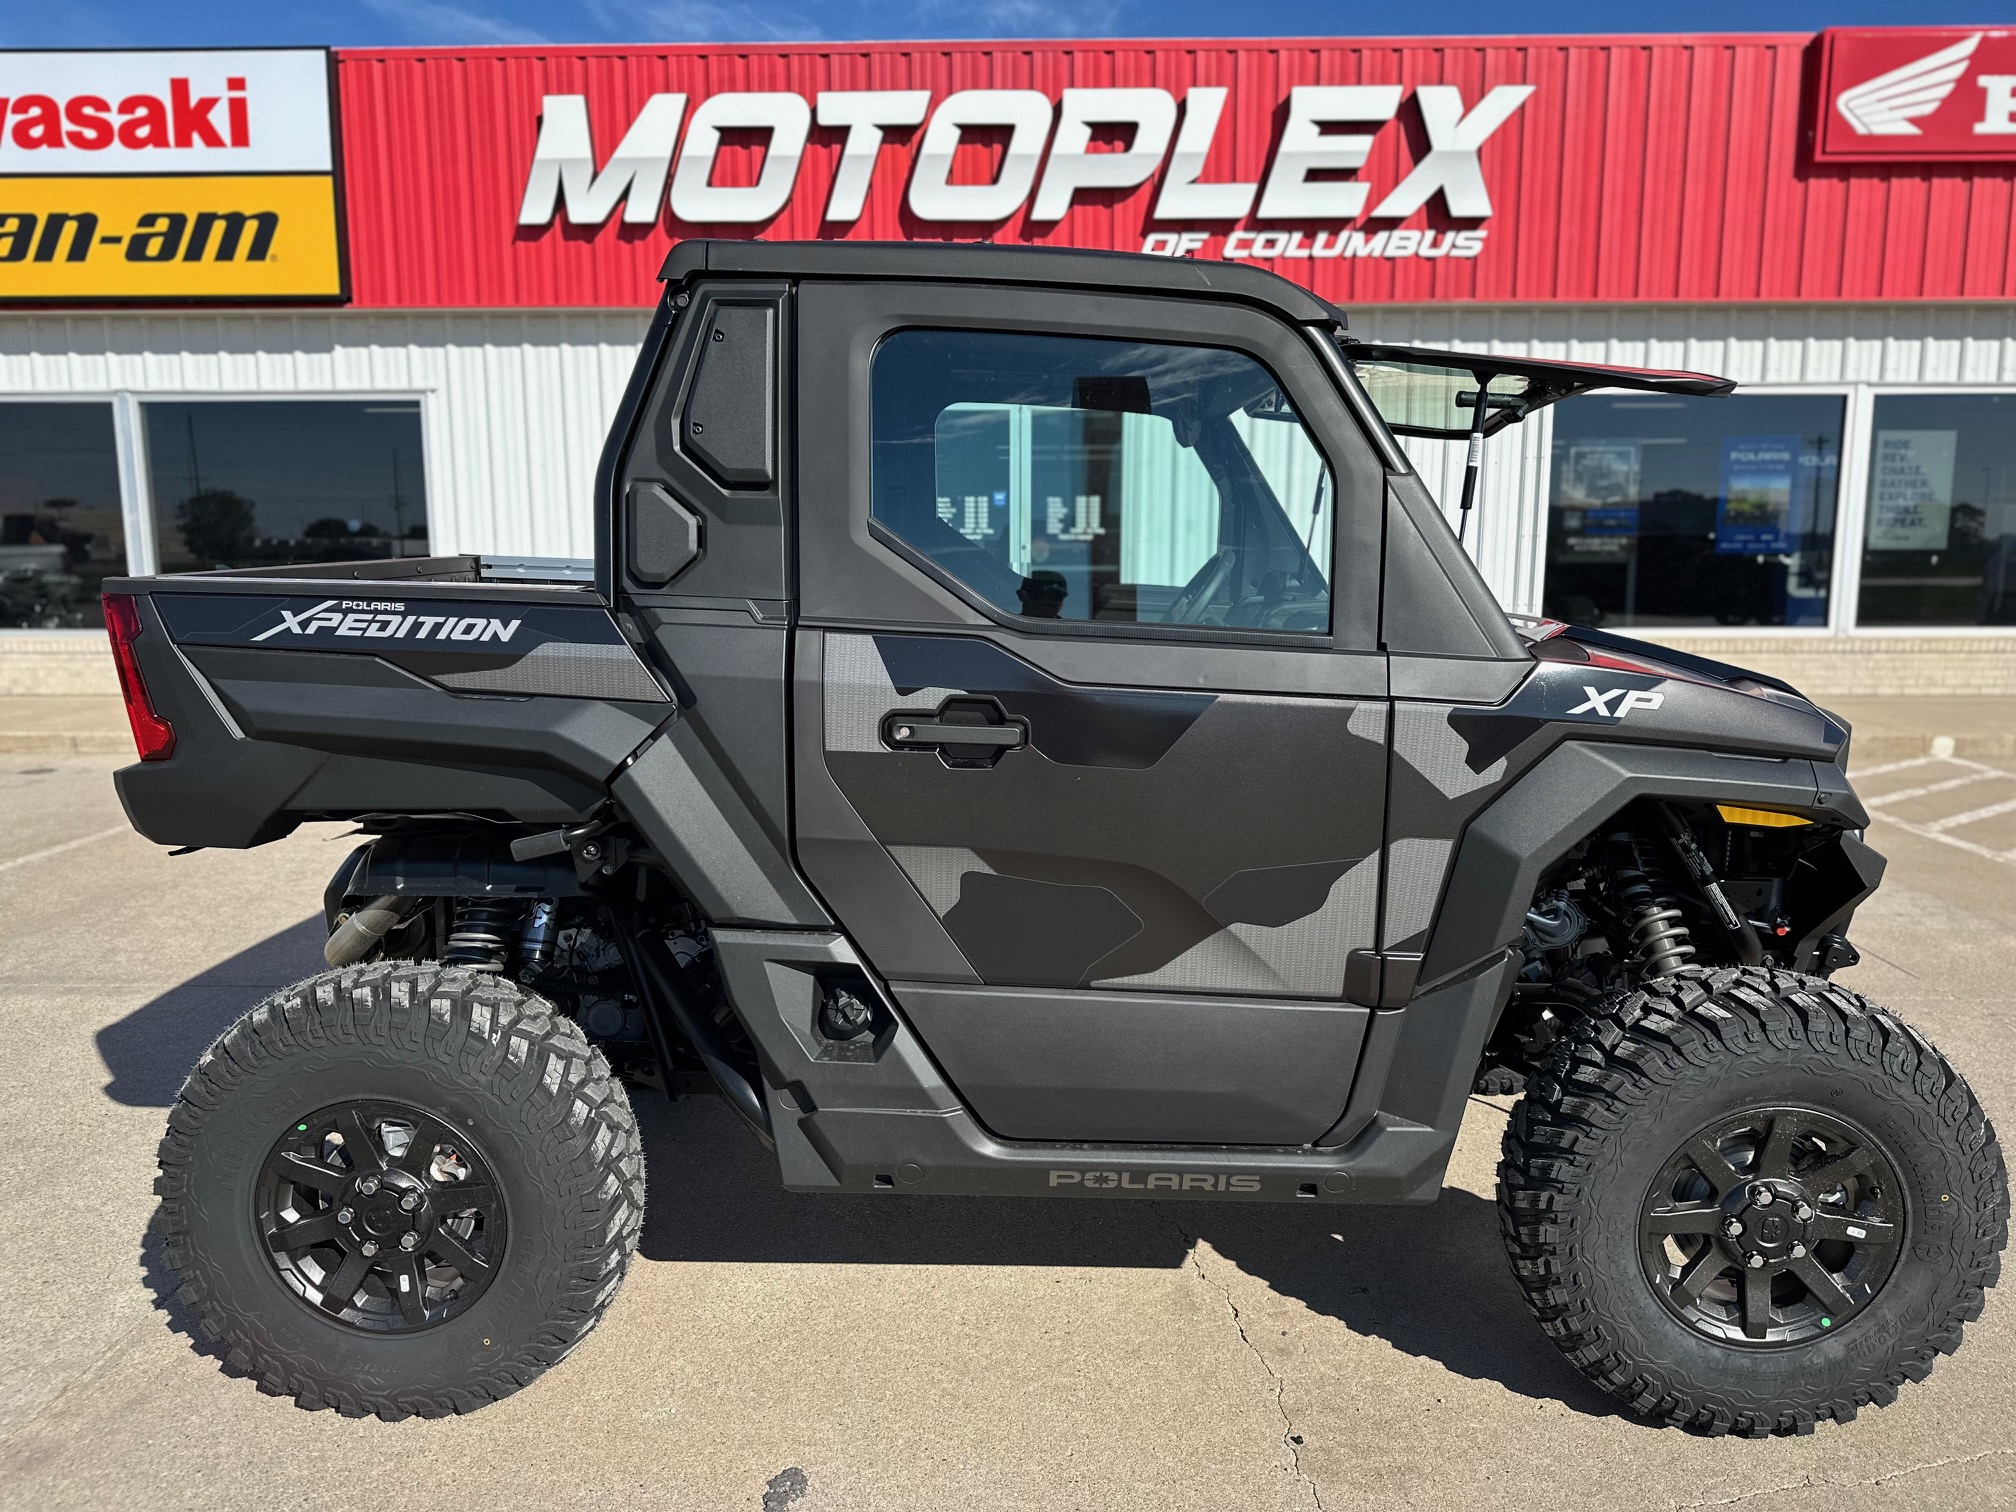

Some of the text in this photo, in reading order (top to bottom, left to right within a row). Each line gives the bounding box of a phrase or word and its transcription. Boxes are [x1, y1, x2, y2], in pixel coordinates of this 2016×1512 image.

[0, 76, 250, 150] asaki
[518, 84, 1536, 225] MOTOPLEX
[1141, 230, 1489, 259] OF COLUMBUS
[1730, 451, 1791, 462] POLARIS
[342, 600, 405, 612] POLARIS
[250, 600, 522, 643] XPEDITION
[1565, 686, 1666, 718] XP
[1049, 1170, 1262, 1192] POLARIS
